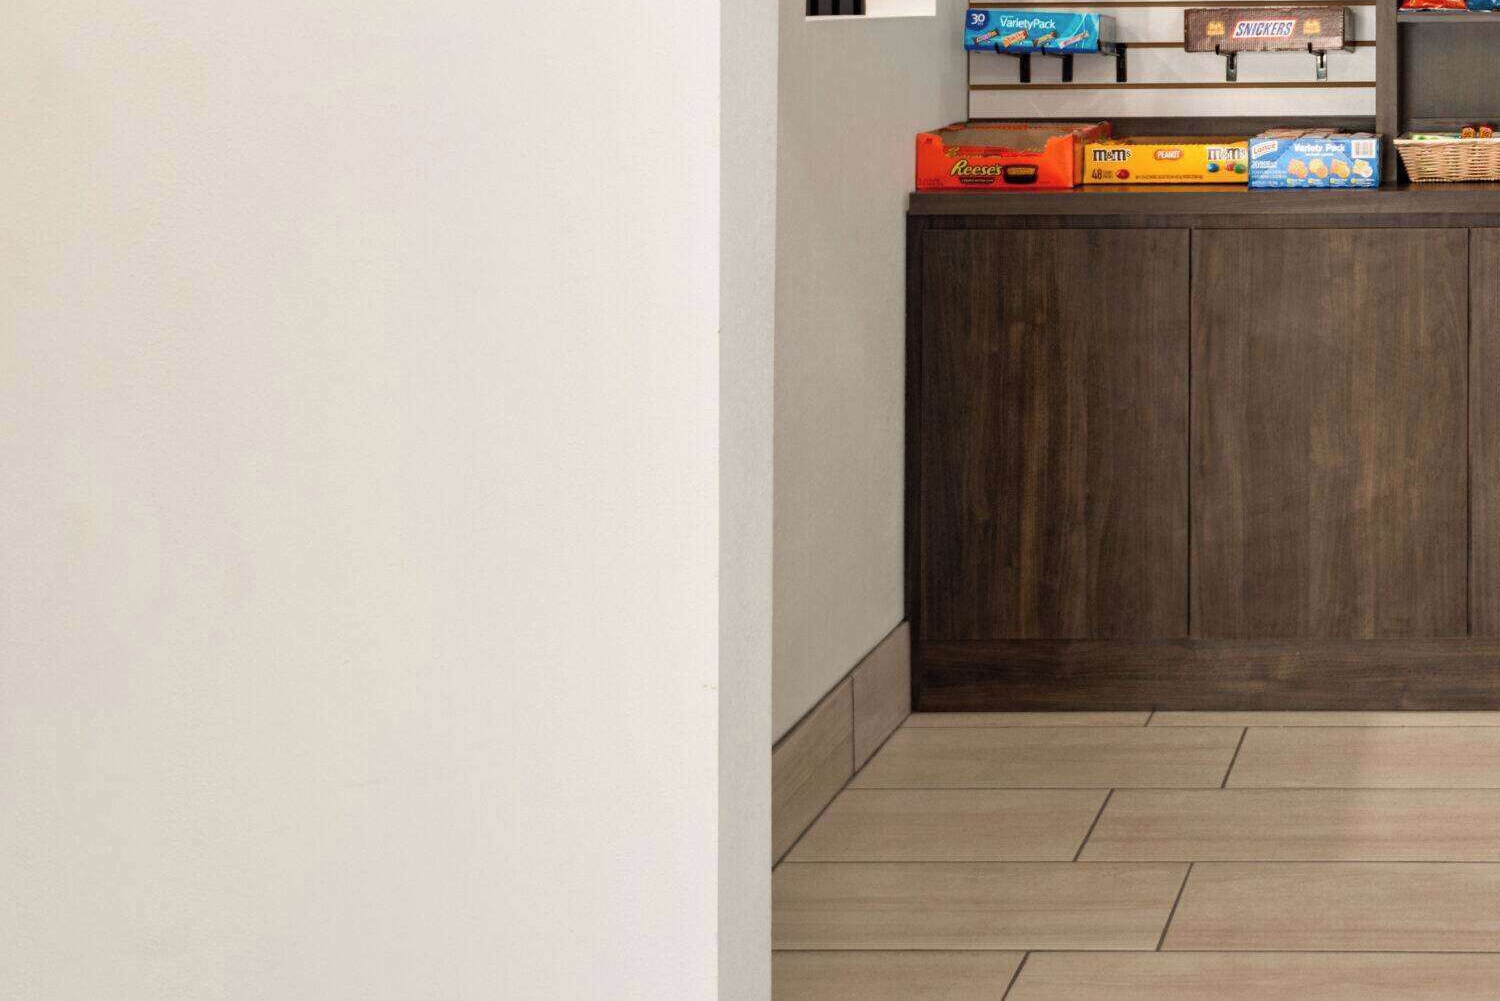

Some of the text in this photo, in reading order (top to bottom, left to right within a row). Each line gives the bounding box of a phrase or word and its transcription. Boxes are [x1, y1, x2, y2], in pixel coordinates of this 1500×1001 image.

[970, 13, 986, 25] 30
[1235, 21, 1293, 37] SNICKERS
[1157, 149, 1181, 159] PEANUT
[1294, 143, 1345, 153] Variety Pack
[950, 159, 1002, 176] Reese's
[1091, 168, 1103, 180] 48
